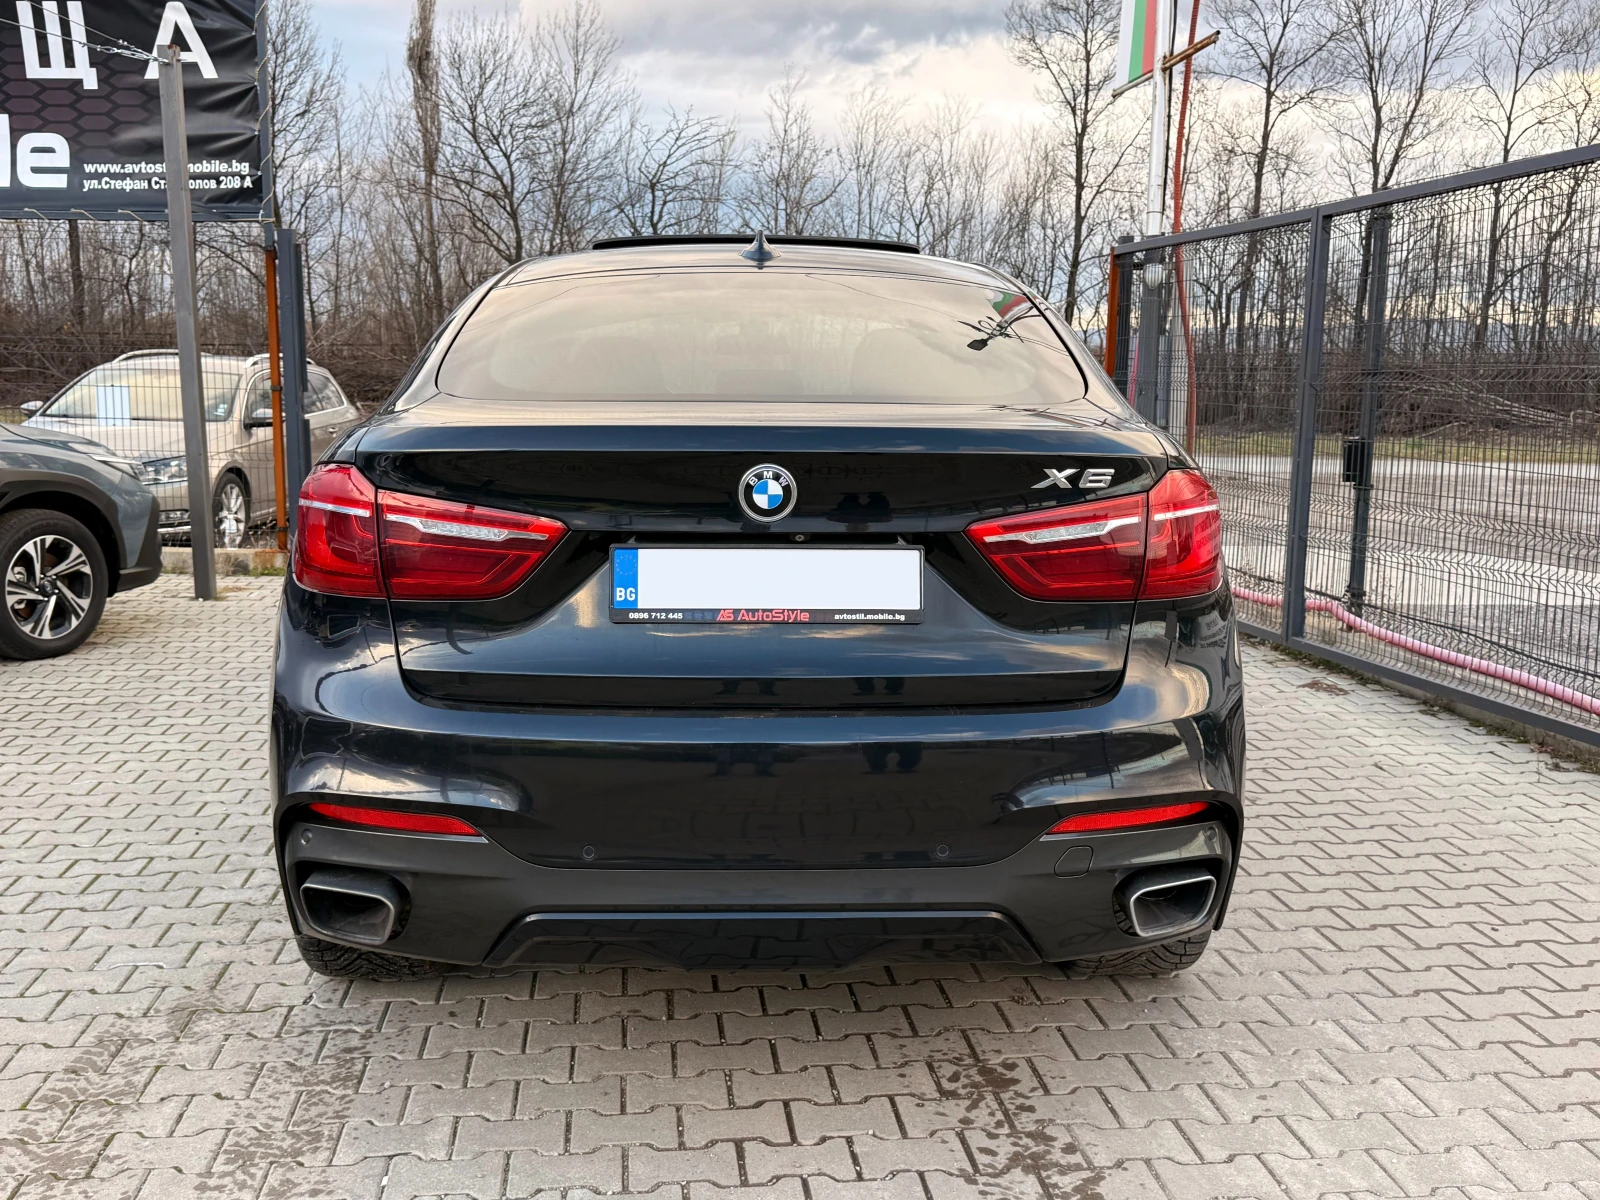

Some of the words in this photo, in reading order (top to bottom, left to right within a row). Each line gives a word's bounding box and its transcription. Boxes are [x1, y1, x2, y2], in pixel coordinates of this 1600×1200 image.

[151, 177, 217, 190] Столов
[219, 176, 241, 189] 208
[748, 471, 789, 487] BMW
[1031, 469, 1115, 488] X6
[616, 587, 636, 601] BG
[717, 609, 734, 621] AS
[738, 609, 810, 622] AutoStyle
[834, 613, 906, 621] avtostil.mobile.bg
